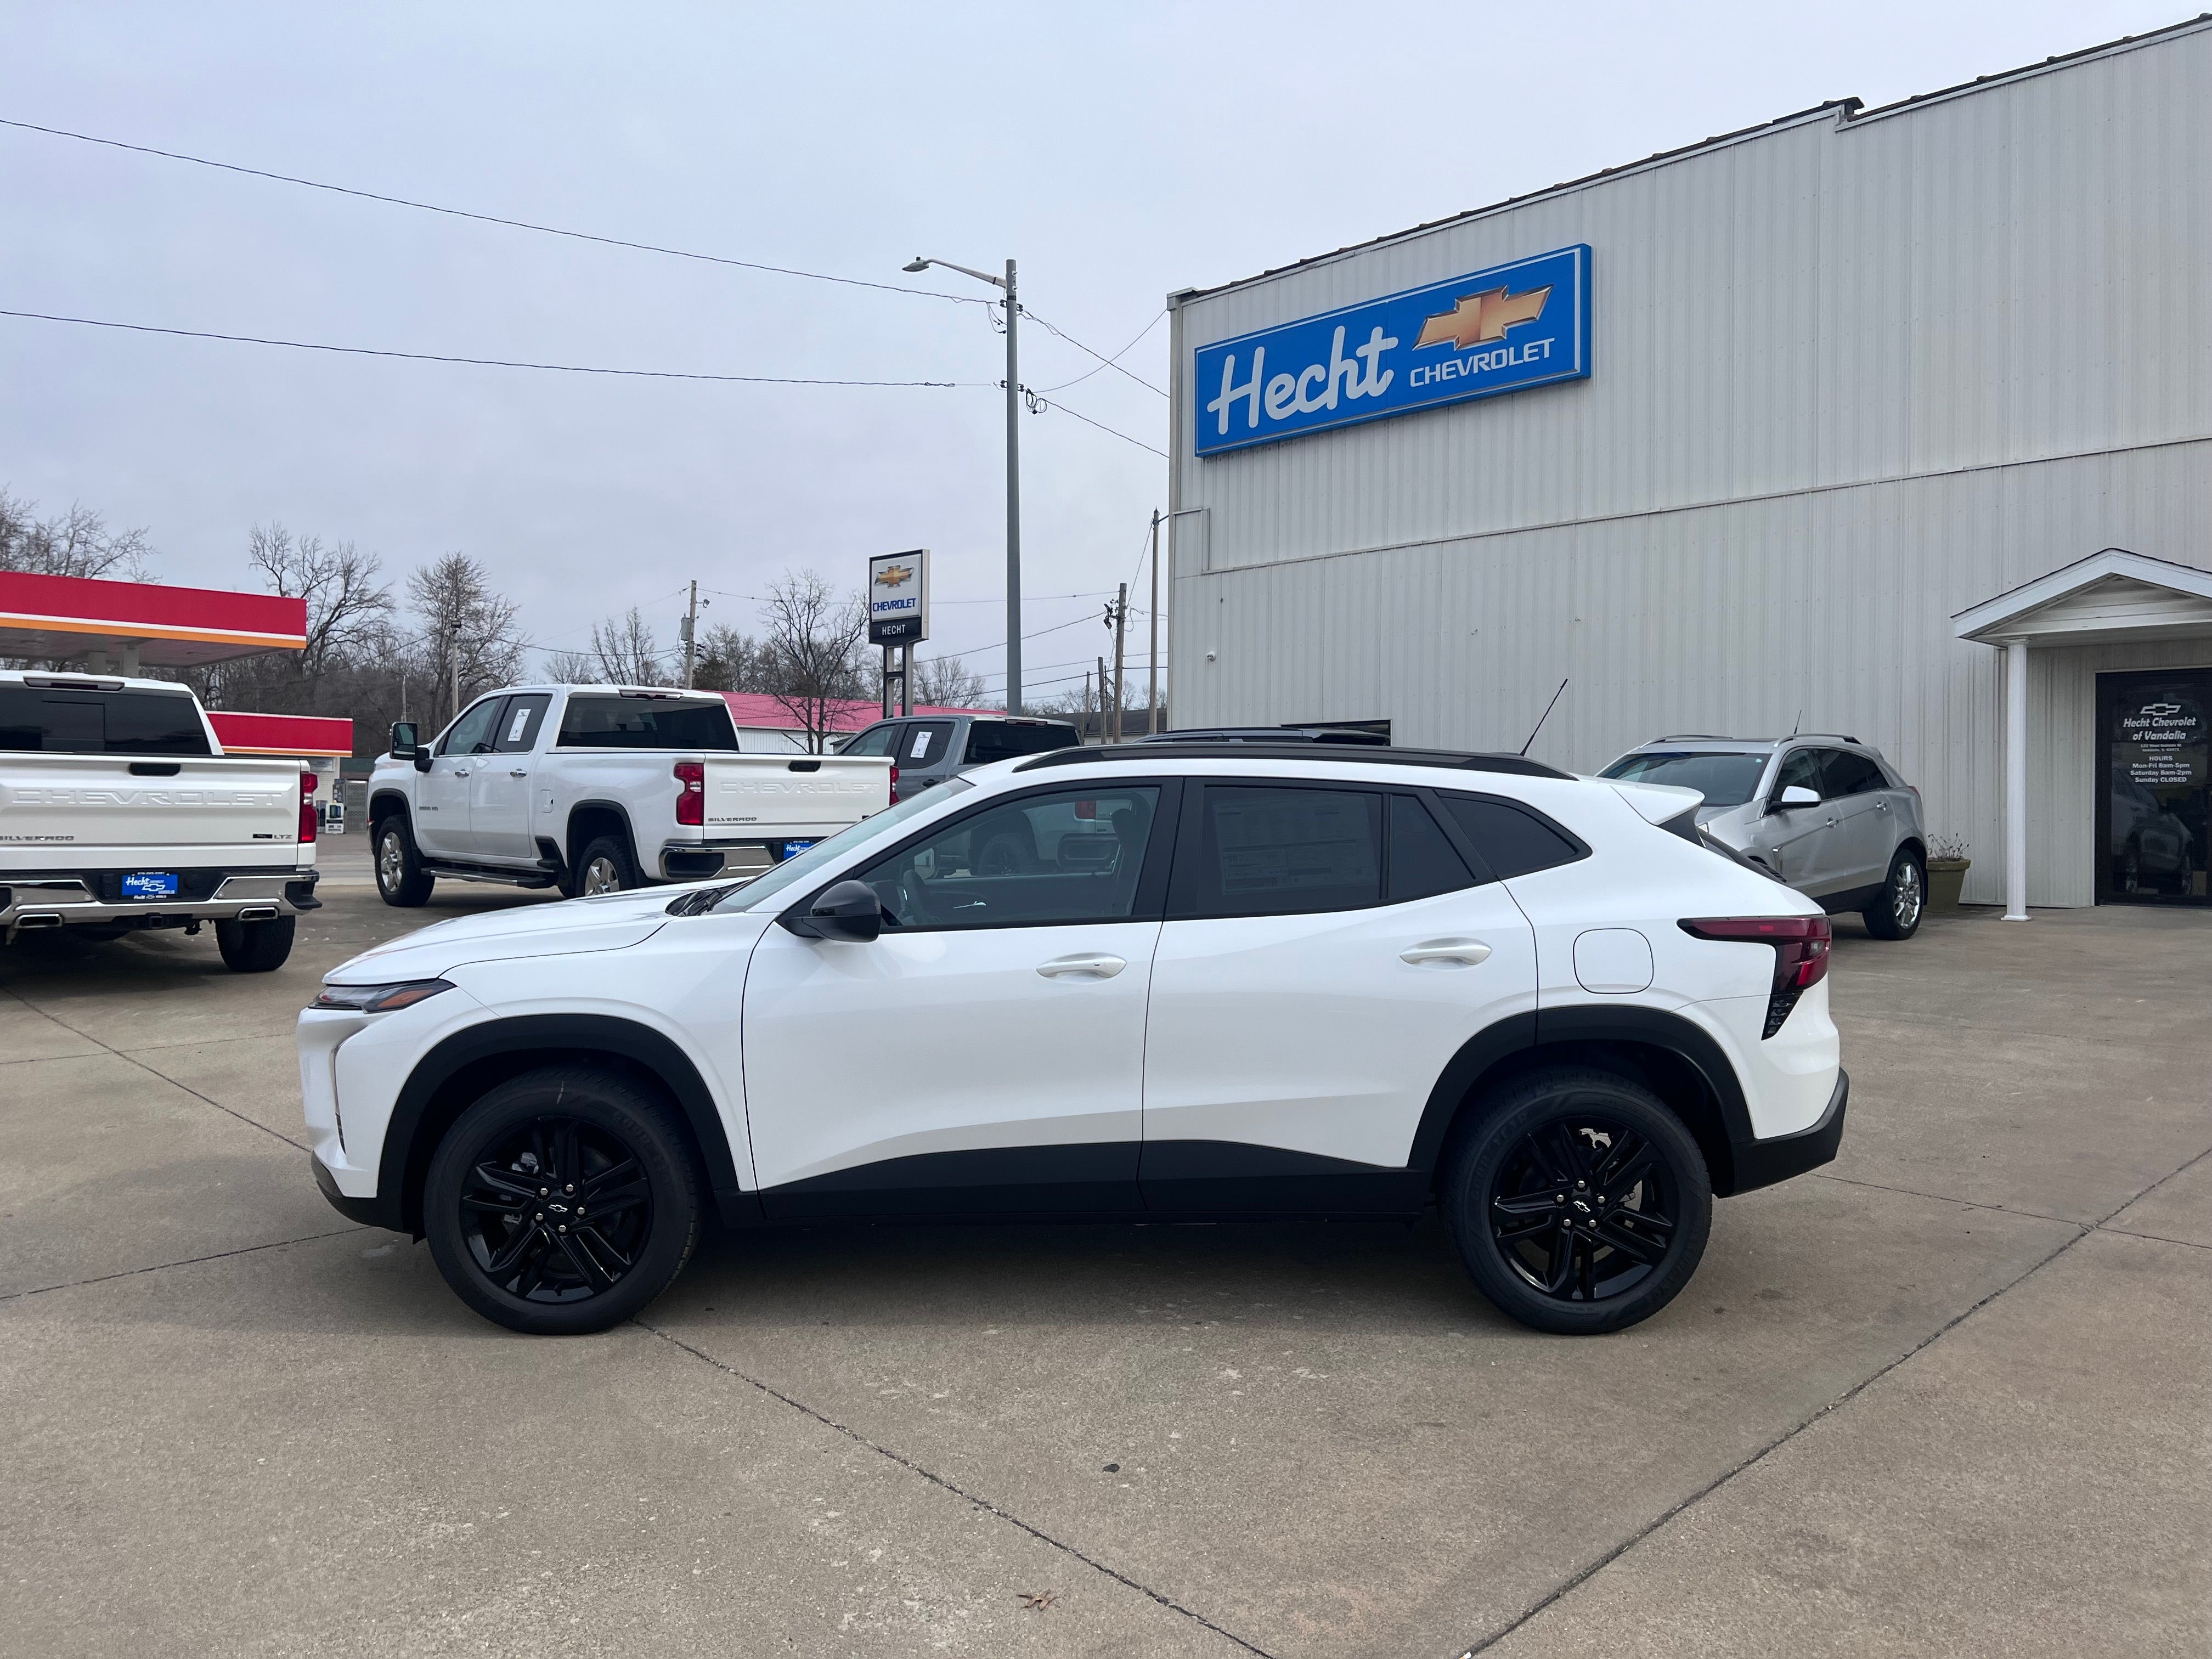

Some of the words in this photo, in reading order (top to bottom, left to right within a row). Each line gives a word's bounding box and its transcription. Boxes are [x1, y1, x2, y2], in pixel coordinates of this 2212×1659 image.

[1409, 337, 1555, 388] CHEVROLET
[1207, 325, 1398, 435] Hecht
[872, 598, 916, 612] CHEVROLET
[882, 624, 905, 635] HECHT
[2123, 718, 2151, 727] Hecht
[2152, 716, 2197, 727] Chevrolet
[2132, 731, 2143, 741] of
[2144, 730, 2186, 740] Vandalia
[719, 782, 881, 794] CHEVROLET
[12, 789, 283, 805] CHEVROLET
[786, 843, 801, 851] Hecht
[126, 876, 150, 886] Hecht
